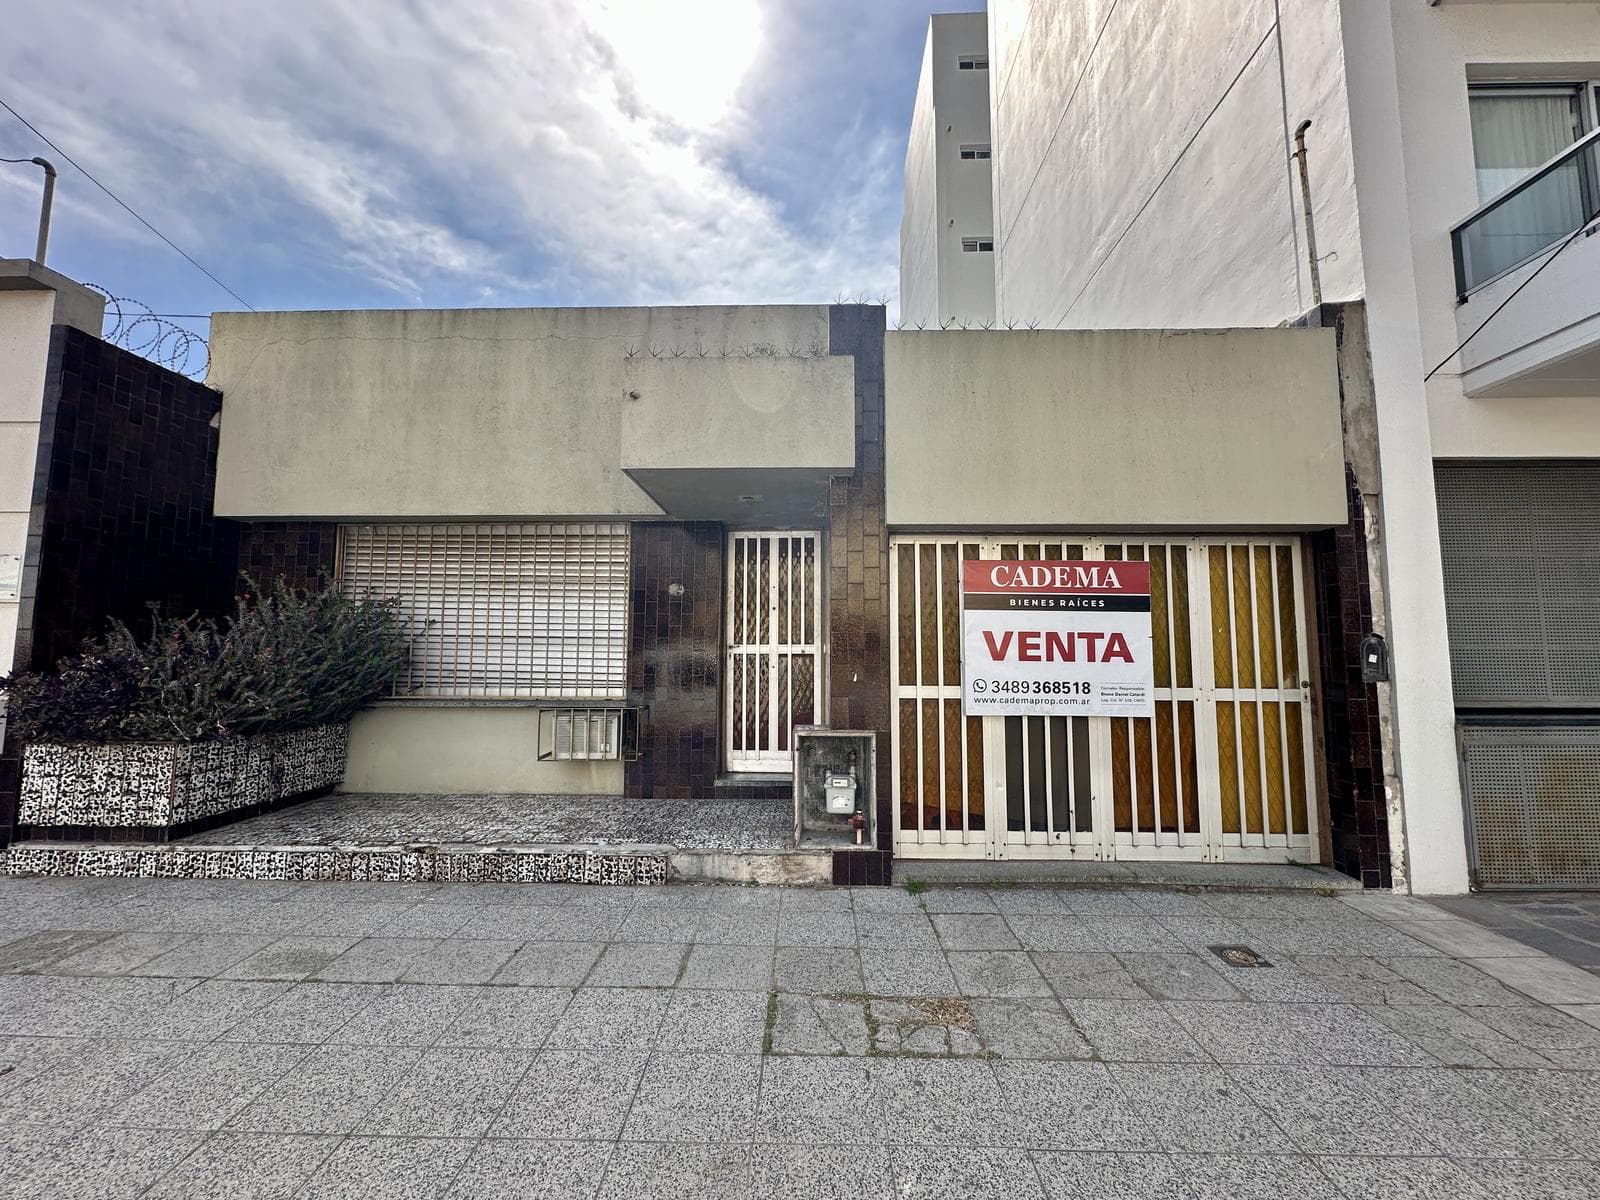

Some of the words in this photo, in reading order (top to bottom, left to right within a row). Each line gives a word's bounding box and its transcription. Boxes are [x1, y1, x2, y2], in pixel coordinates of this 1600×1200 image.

[990, 565, 1123, 589] CADEMA
[1009, 598, 1055, 607] BIENES
[1060, 597, 1105, 607] RAÍCES
[982, 630, 1135, 664] VENTA
[973, 696, 1091, 706] www.cademaprop.com.ar
